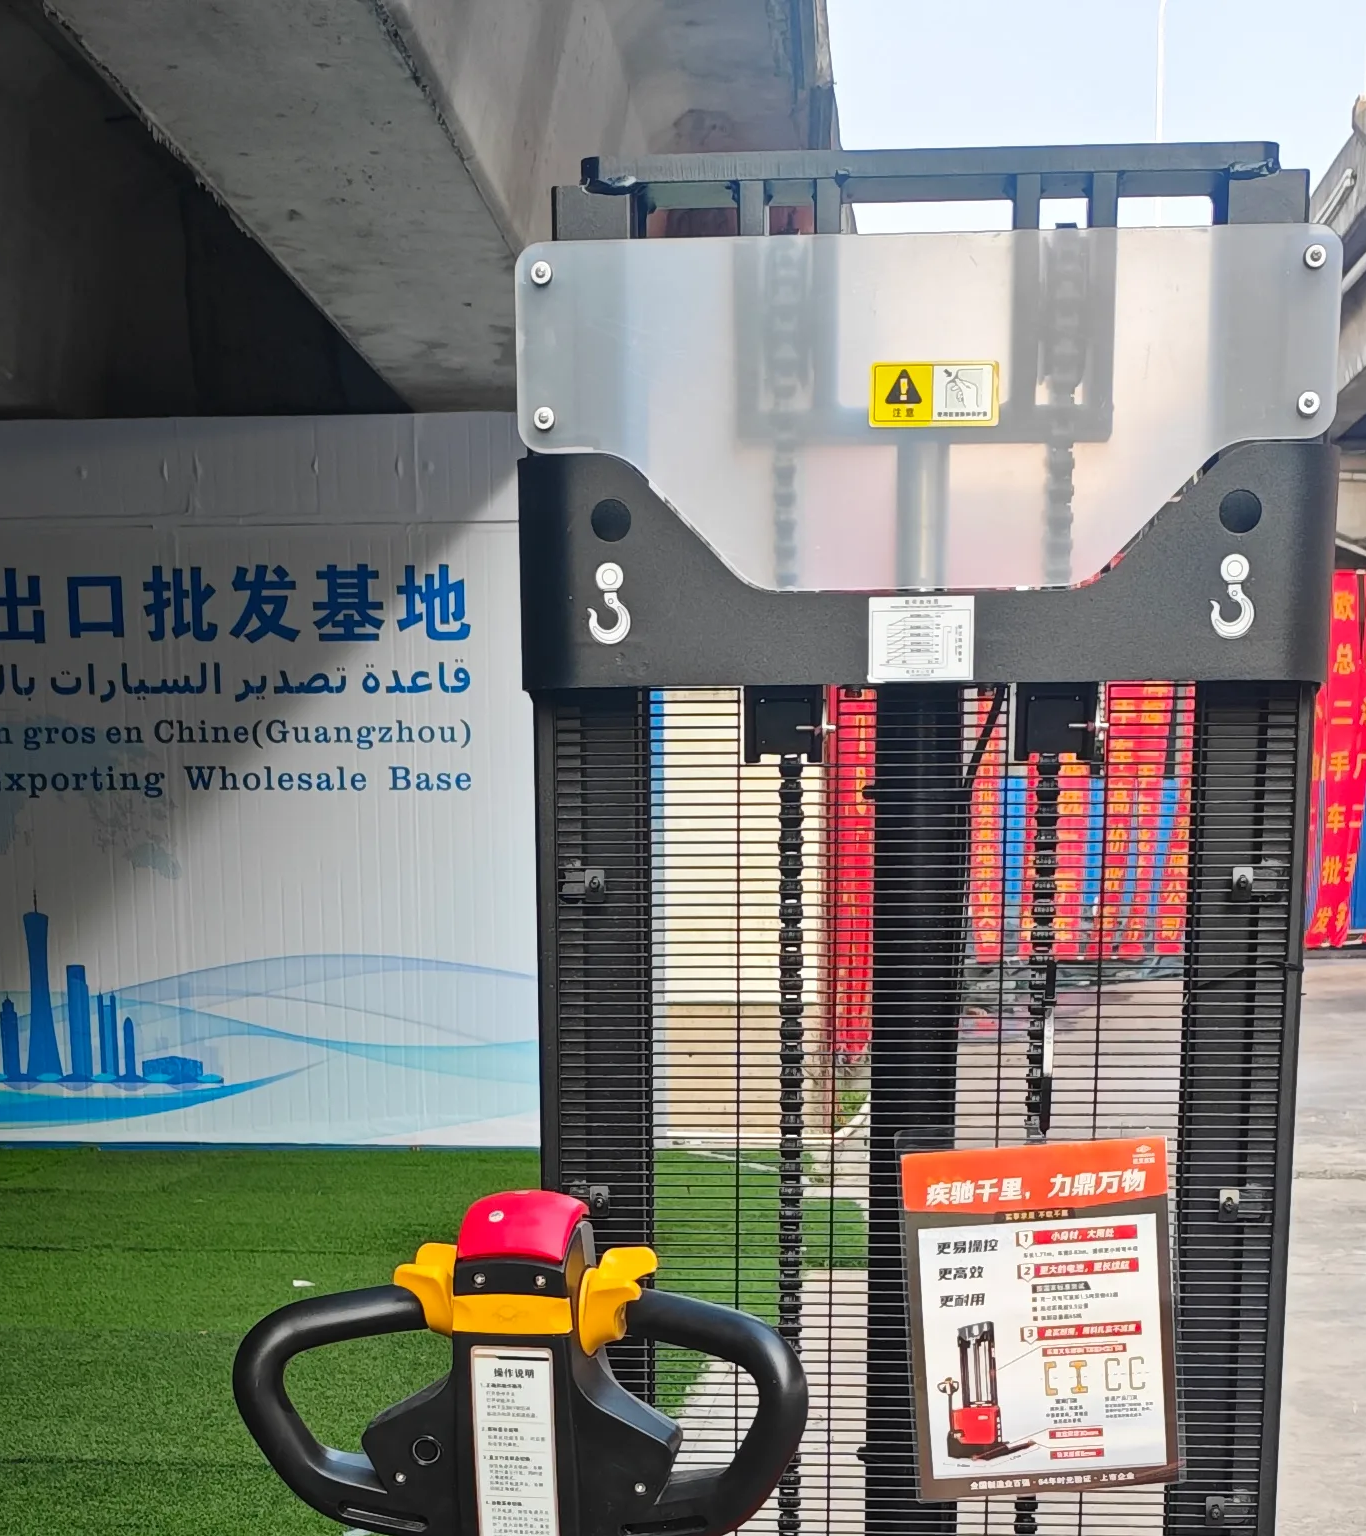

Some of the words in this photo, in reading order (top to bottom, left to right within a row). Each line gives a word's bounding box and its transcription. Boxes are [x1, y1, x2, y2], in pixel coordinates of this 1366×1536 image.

[892, 407, 915, 418] 注意
[50, 662, 221, 702] السيارات
[235, 665, 348, 701] تصدير
[361, 660, 472, 695] قاعدة
[24, 726, 96, 749] gros
[106, 724, 144, 744] en
[154, 719, 473, 750] Chine(Guangzhou)
[1315, 590, 1356, 936] 欧总二手车批发
[184, 765, 367, 791] Wholesale
[388, 765, 472, 791] Base
[937, 1238, 999, 1256] 更易操控
[937, 1265, 985, 1282] 更高效
[1024, 1267, 1030, 1275] 2
[938, 1293, 986, 1308] 更耐用
[1027, 1329, 1034, 1338] 3
[493, 1367, 535, 1379] 操作说明
